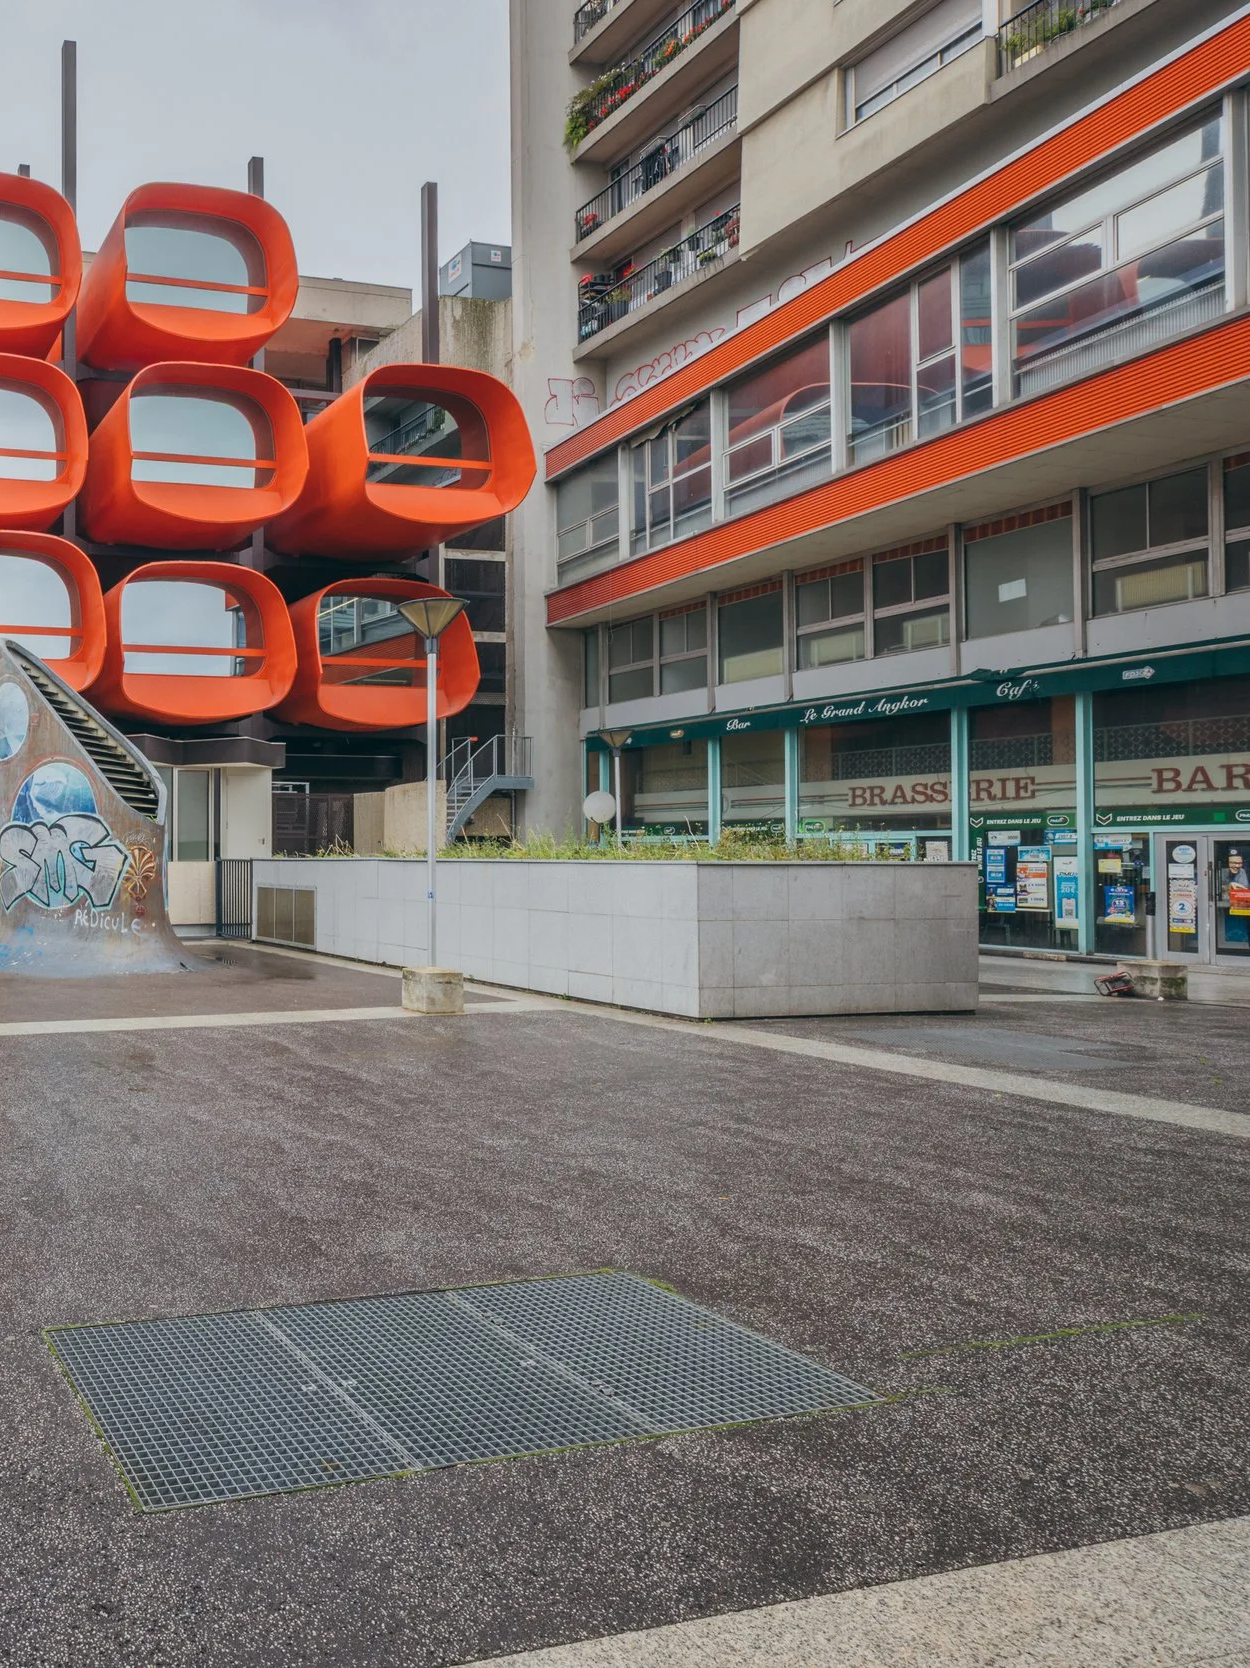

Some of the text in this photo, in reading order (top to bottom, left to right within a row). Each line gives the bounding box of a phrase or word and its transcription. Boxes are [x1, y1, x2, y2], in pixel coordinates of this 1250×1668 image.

[726, 718, 751, 731] Bar
[800, 696, 929, 724] Le Grand Angkor
[848, 776, 1036, 808] BRASSRIE
[1151, 763, 1250, 793] BAR
